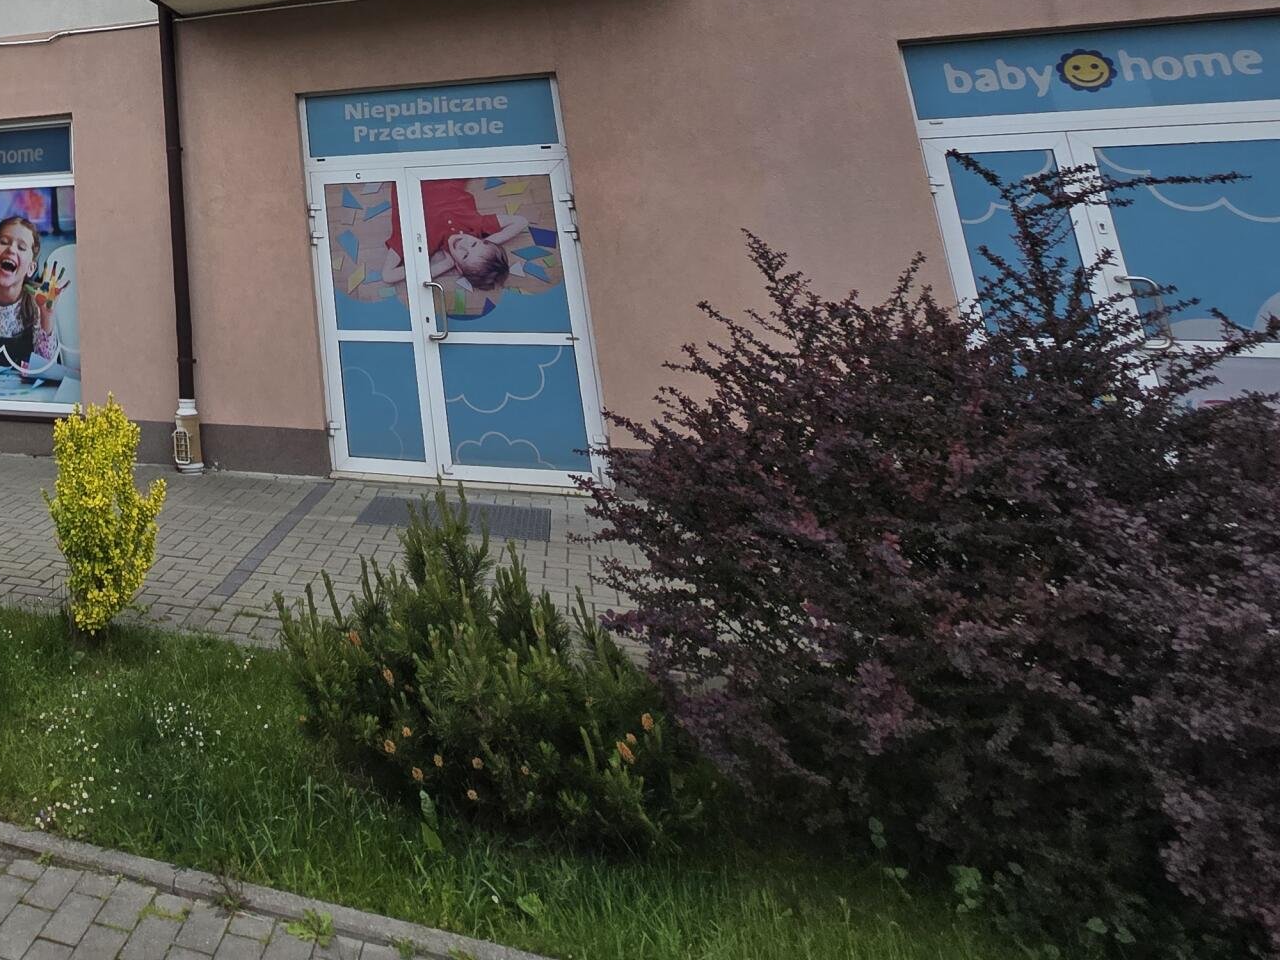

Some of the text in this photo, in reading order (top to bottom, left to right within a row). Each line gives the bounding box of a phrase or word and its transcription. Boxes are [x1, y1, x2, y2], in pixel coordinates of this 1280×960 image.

[943, 48, 1264, 97] baby home
[344, 95, 509, 122] Niepubliczne
[353, 117, 504, 143] Przedszkole
